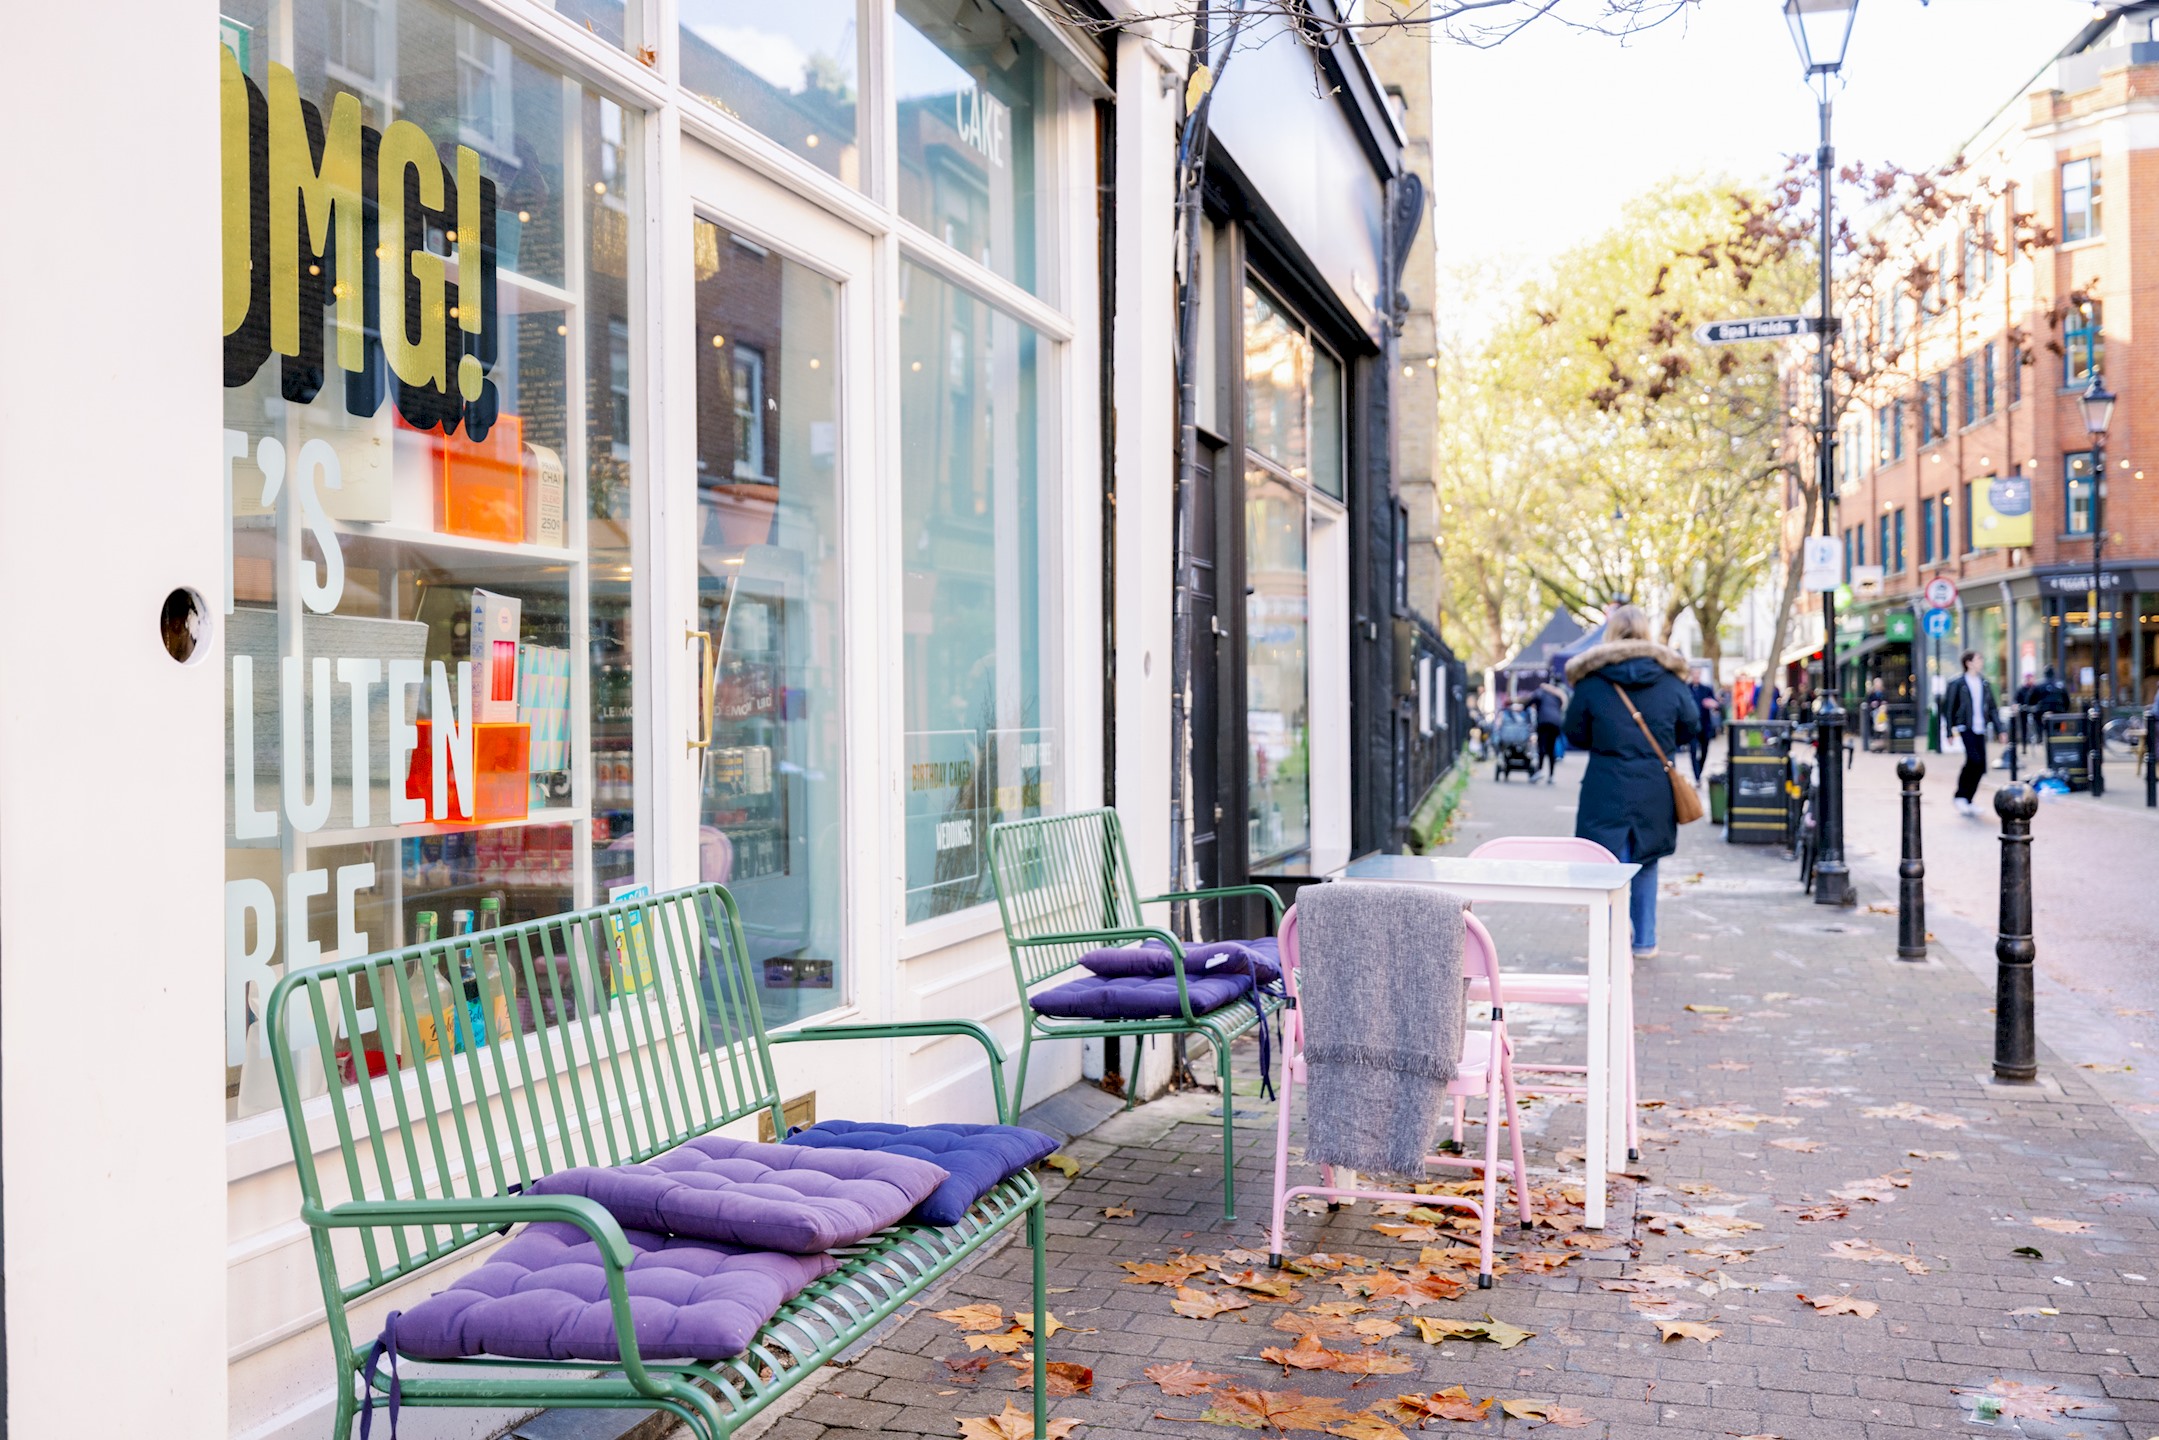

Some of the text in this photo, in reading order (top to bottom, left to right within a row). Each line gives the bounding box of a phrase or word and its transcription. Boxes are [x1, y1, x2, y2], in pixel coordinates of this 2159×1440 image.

[956, 85, 1004, 168] CAKE
[1719, 320, 1792, 341] Spa Fields
[542, 471, 560, 486] CHAI
[233, 655, 472, 840] LUTEN
[911, 760, 971, 792] BIRTHDAY CAKES
[936, 818, 972, 851] WEDDINGS
[225, 862, 378, 1068] REE
